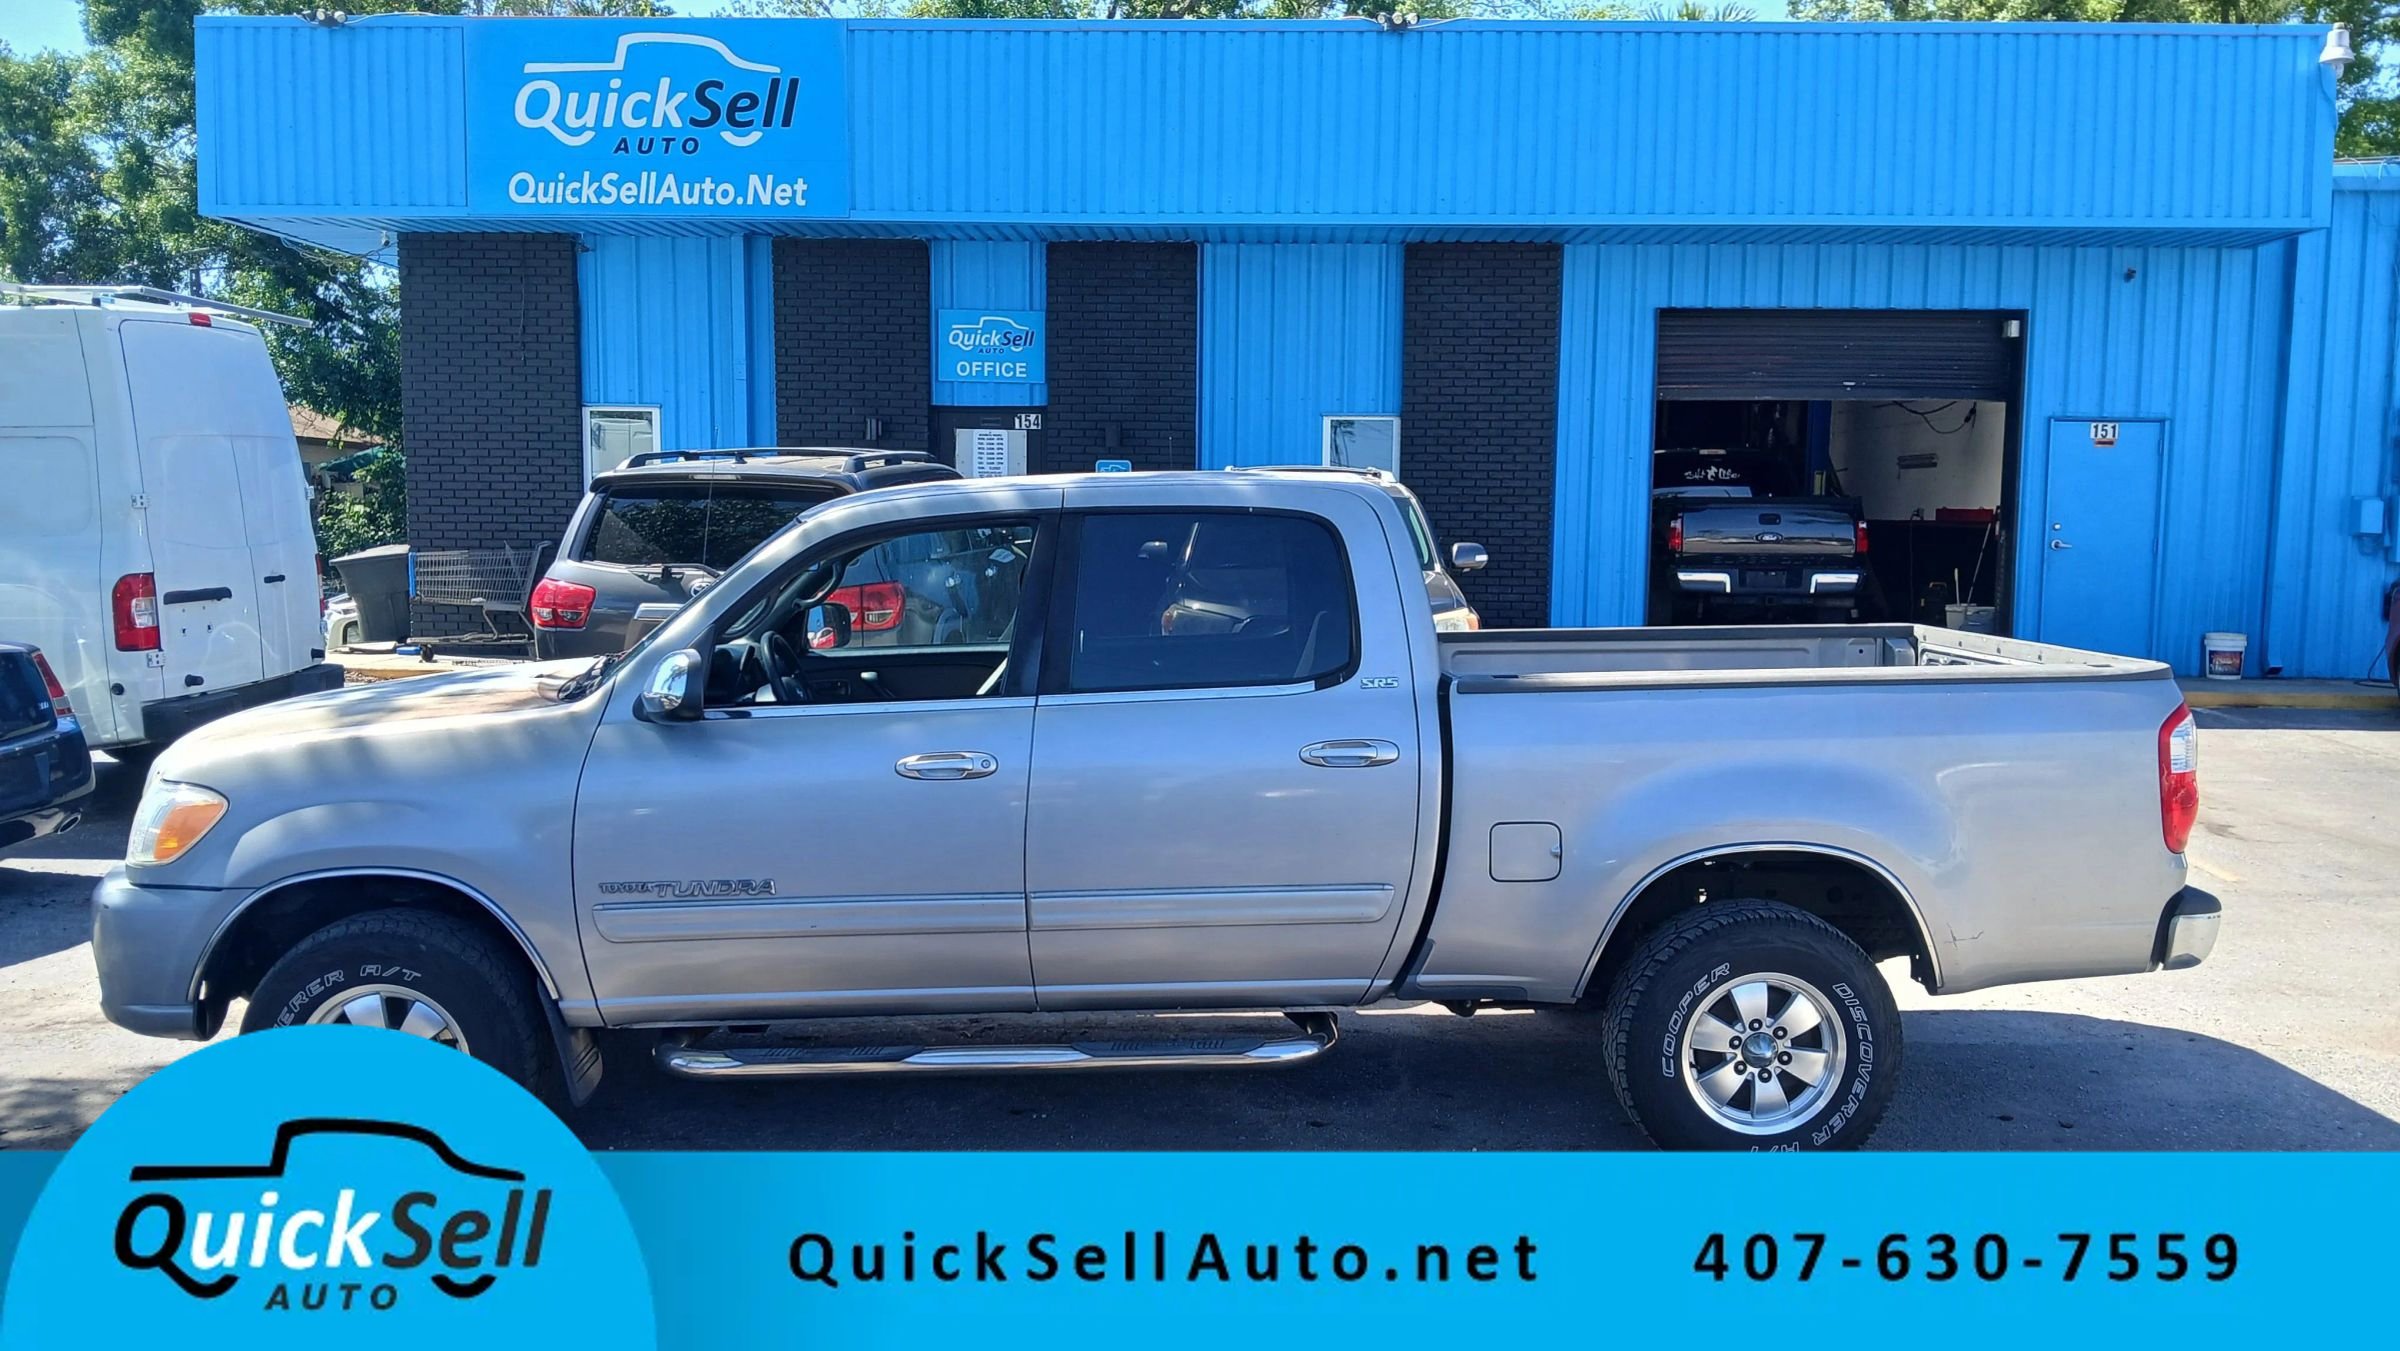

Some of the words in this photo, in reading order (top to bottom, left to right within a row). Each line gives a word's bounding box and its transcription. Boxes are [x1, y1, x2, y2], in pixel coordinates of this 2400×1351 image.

[515, 77, 800, 146] QuickSell
[613, 137, 699, 155] AUTO
[508, 171, 808, 207] QuickSellAuto.Net
[948, 329, 1035, 351] QuickSell
[956, 361, 1027, 378] OFFICE
[1016, 413, 1041, 429] 154
[2093, 423, 2117, 438] 151
[1360, 676, 1399, 690] SR5
[598, 881, 656, 895] TOYOTA
[653, 878, 777, 898] TUNDRA
[359, 964, 422, 982] A/T
[1660, 961, 1732, 1078] COOPER
[1811, 982, 1874, 1146] DISCOVERER
